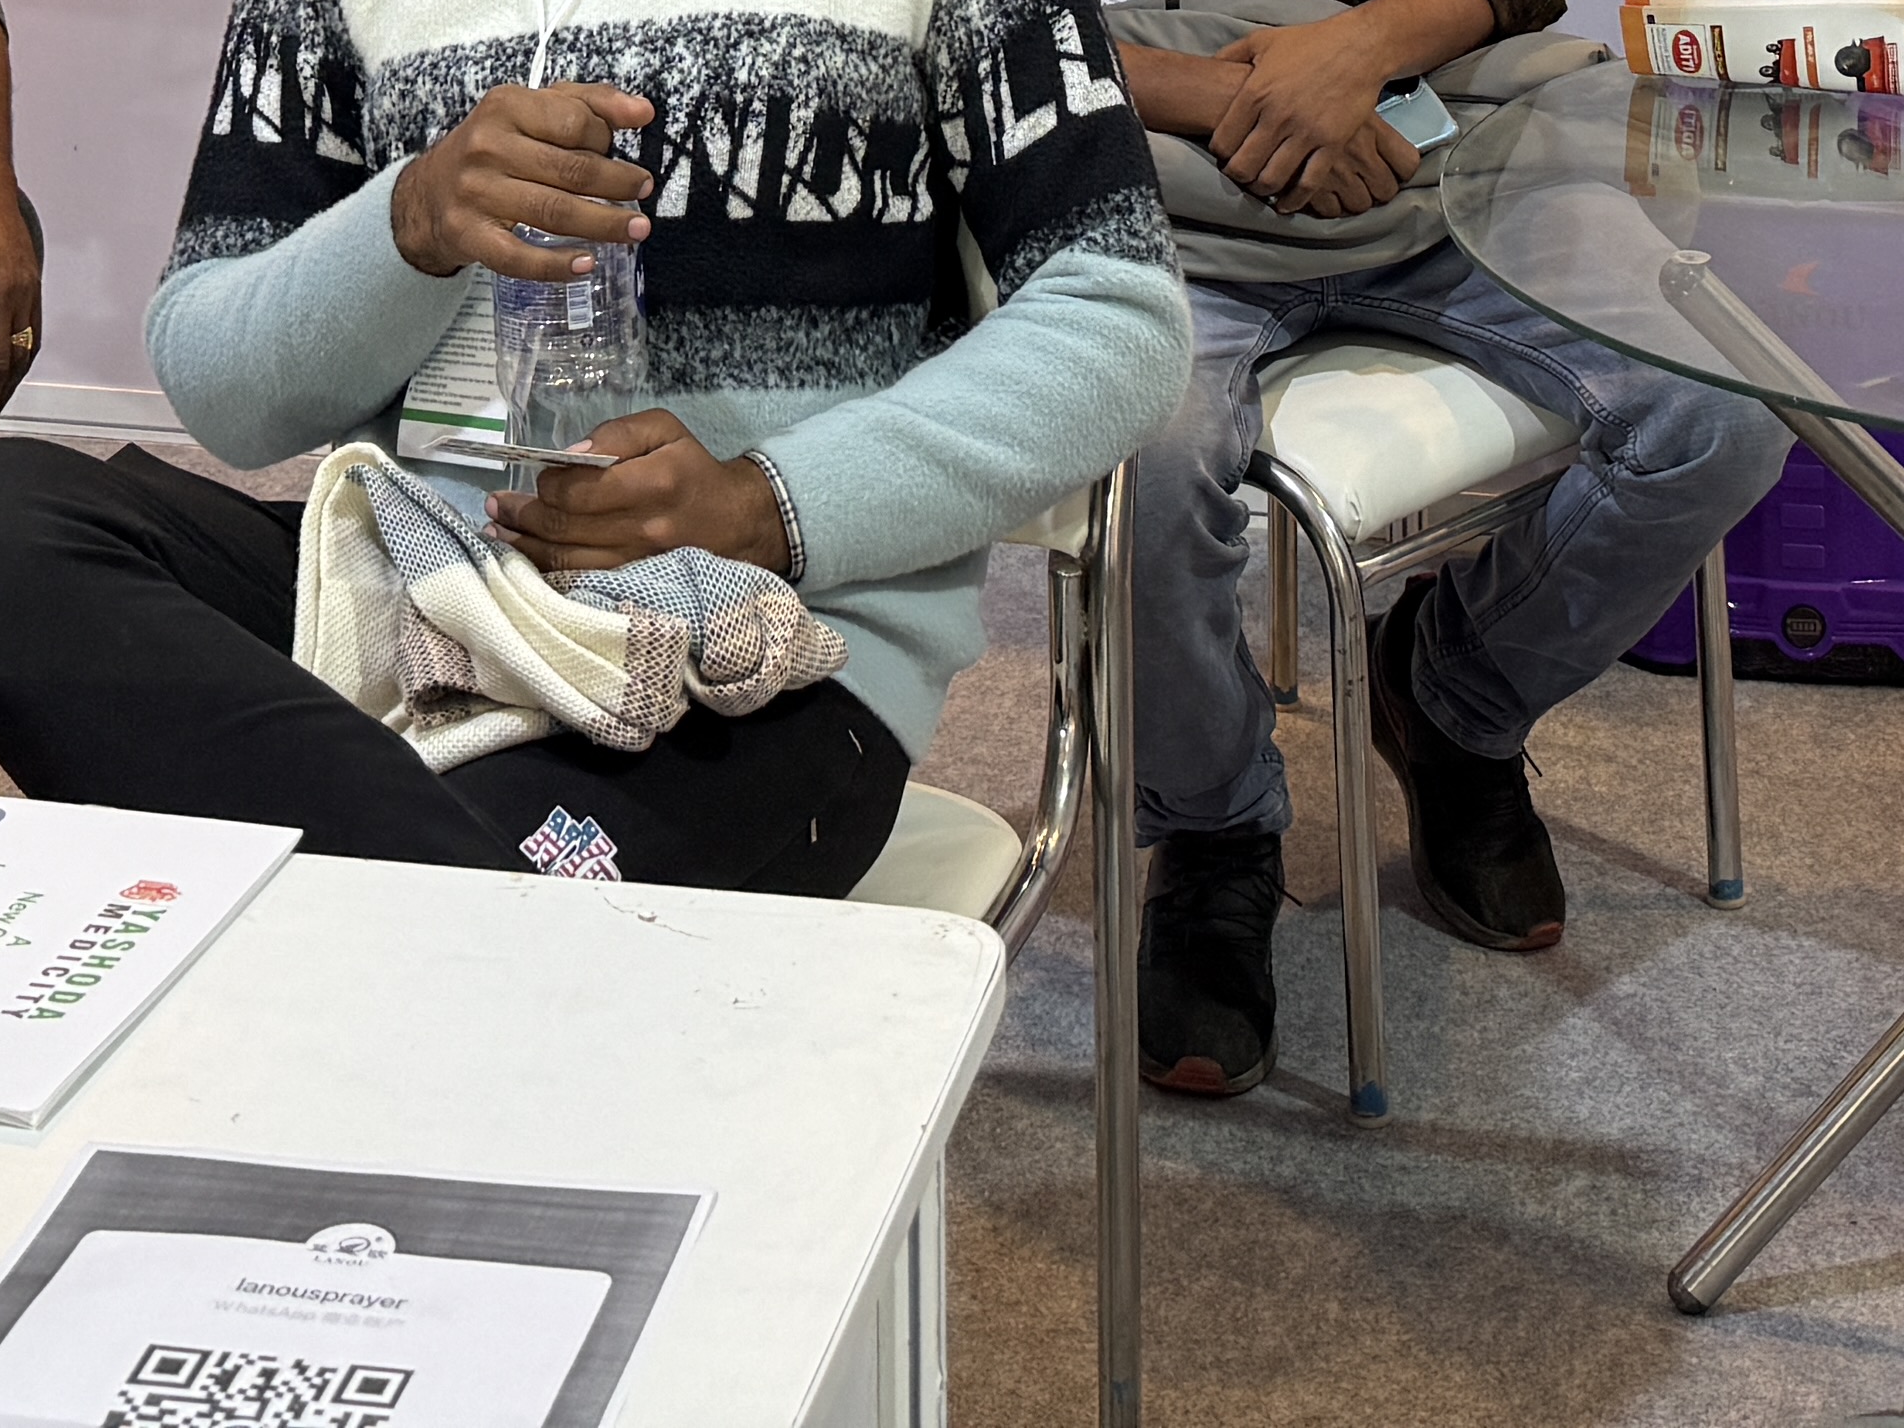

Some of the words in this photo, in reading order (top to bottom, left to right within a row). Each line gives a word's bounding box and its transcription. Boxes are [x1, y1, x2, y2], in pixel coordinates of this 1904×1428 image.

[1677, 32, 1695, 74] ADITI
[1, 904, 131, 1018] MEDICITY
[6, 936, 31, 946] A
[28, 910, 167, 1019] YASHODA
[236, 1277, 408, 1310] lanousprayer
